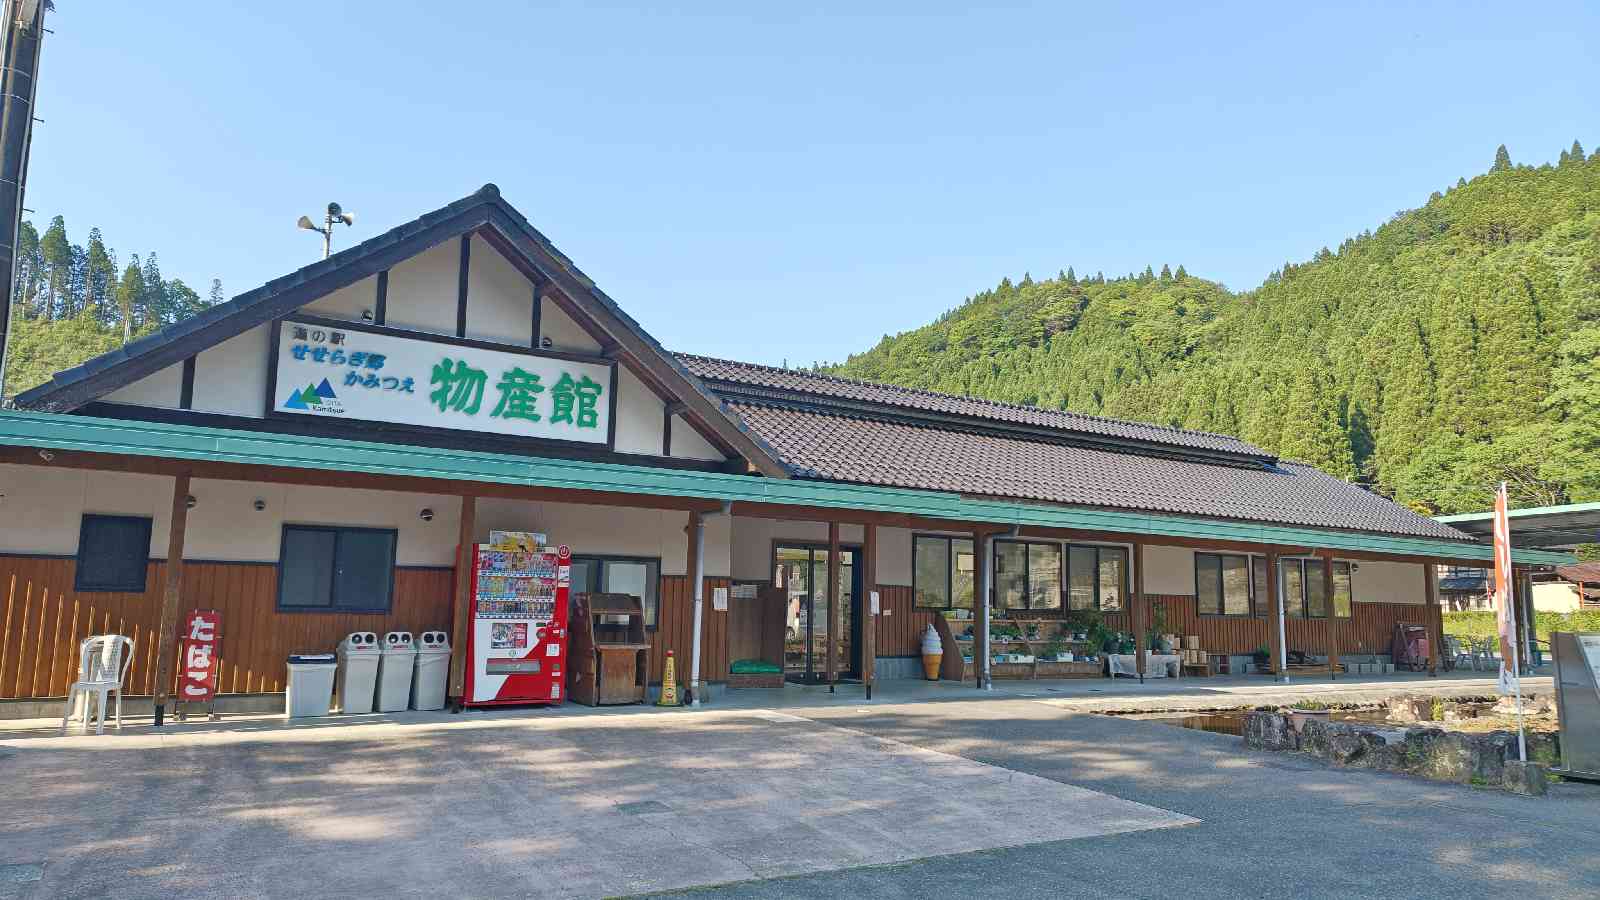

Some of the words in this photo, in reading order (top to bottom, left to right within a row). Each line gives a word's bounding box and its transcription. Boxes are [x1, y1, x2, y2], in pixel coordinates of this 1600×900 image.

[344, 371, 415, 392] かみつえ
[430, 357, 603, 429] 物産館
[184, 616, 215, 696] たばこ
